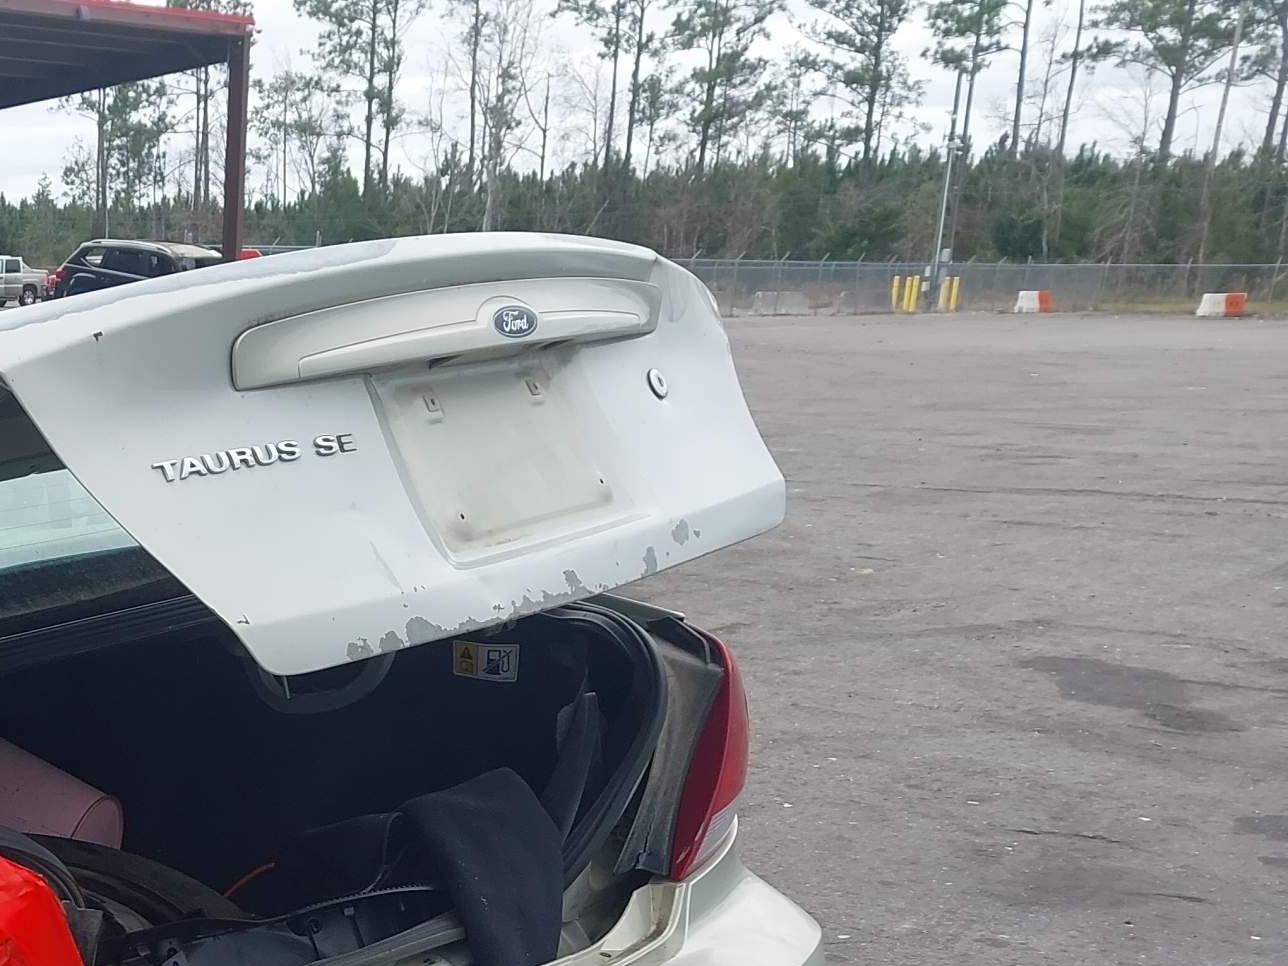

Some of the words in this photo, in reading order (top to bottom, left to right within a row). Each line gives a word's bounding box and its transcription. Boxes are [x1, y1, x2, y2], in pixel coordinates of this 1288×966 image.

[502, 310, 529, 331] Ford
[151, 439, 302, 482] TAURUS
[312, 433, 358, 457] SE
